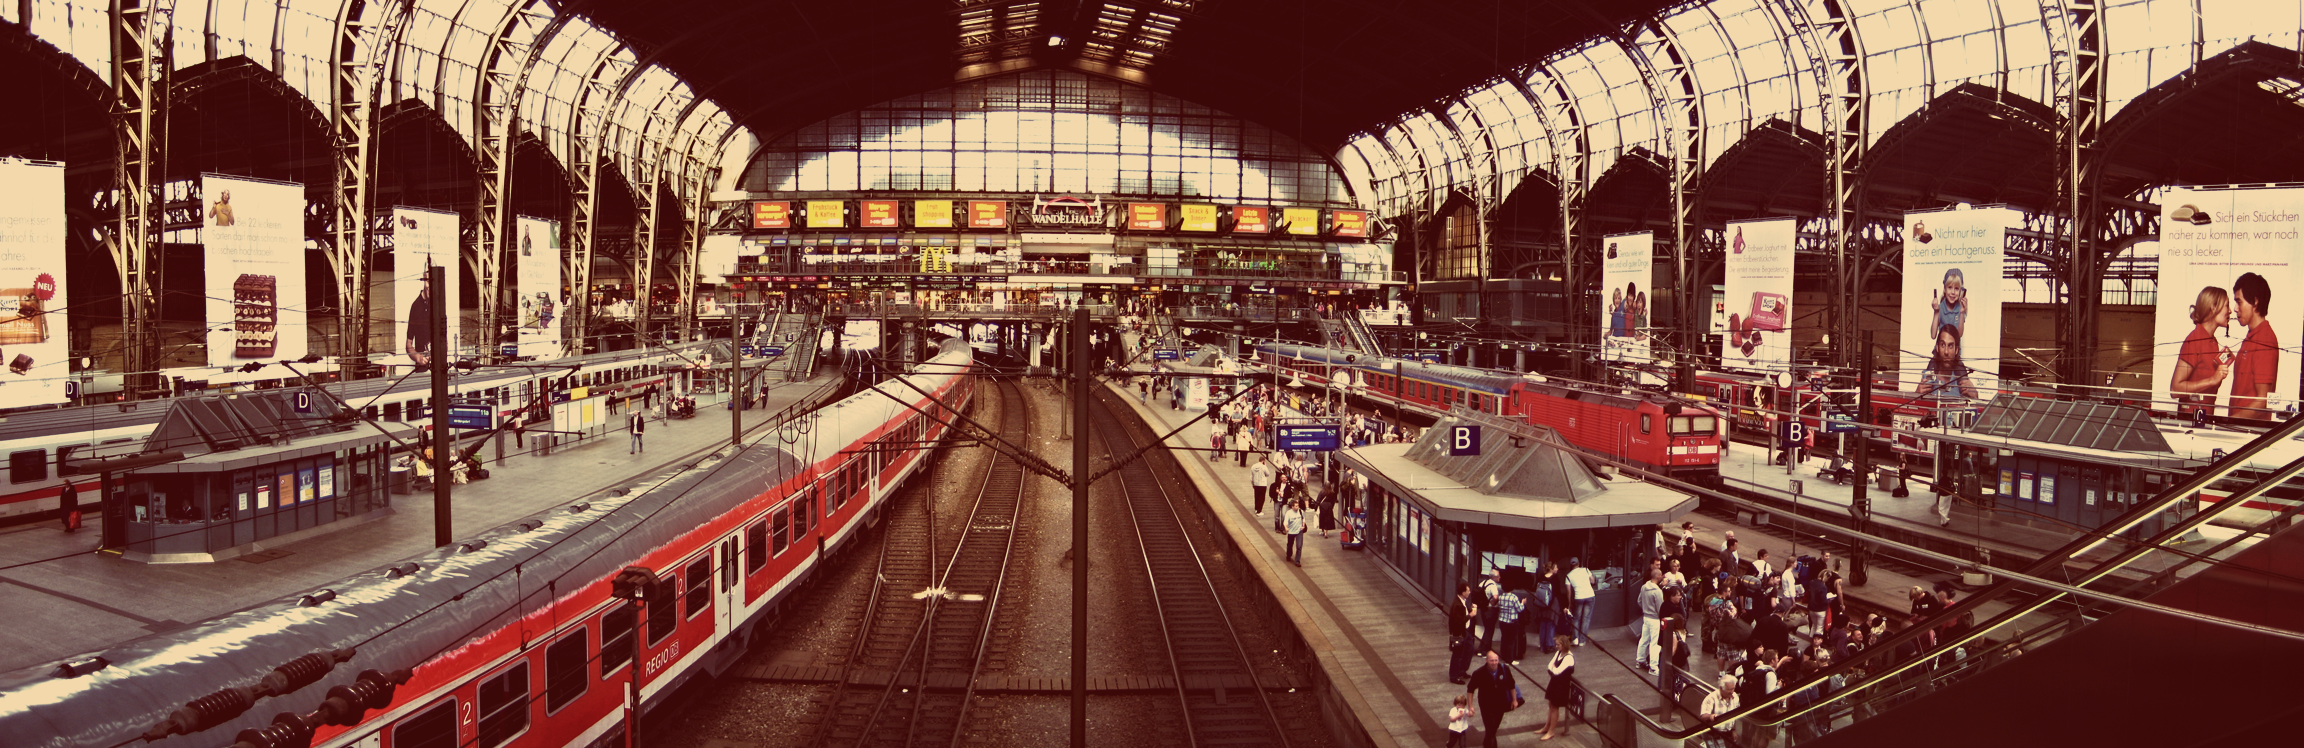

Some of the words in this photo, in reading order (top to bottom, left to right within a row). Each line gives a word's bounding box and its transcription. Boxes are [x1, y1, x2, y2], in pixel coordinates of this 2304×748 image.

[248, 218, 257, 228] 22
[1032, 214, 1102, 224] WANDELHALLE
[2215, 211, 2233, 223] Sich
[2237, 213, 2250, 222] ein
[2253, 210, 2300, 222] Stückchen
[212, 230, 232, 240] Sorten
[1935, 226, 1954, 239] Nicht
[1957, 230, 1969, 238] nur
[1971, 225, 1986, 237] hier
[2169, 228, 2193, 240] näher
[2210, 228, 2250, 241] kommen,
[2253, 231, 2272, 240] war
[2275, 227, 2298, 239] noch
[1910, 245, 1929, 257] oben
[1931, 246, 1942, 256] ein
[1945, 243, 1996, 259] Hochgenuss.
[2168, 247, 2180, 256] nie
[2183, 248, 2193, 256] so
[2196, 245, 2223, 256] lecker.
[37, 282, 53, 292] NEU
[66, 382, 73, 394] D
[299, 393, 308, 408] D
[1455, 428, 1470, 449] B
[1790, 422, 1802, 441] B
[678, 578, 683, 595] 2
[645, 648, 669, 678] REGIO
[670, 640, 679, 658] DB
[463, 702, 472, 725] 2
